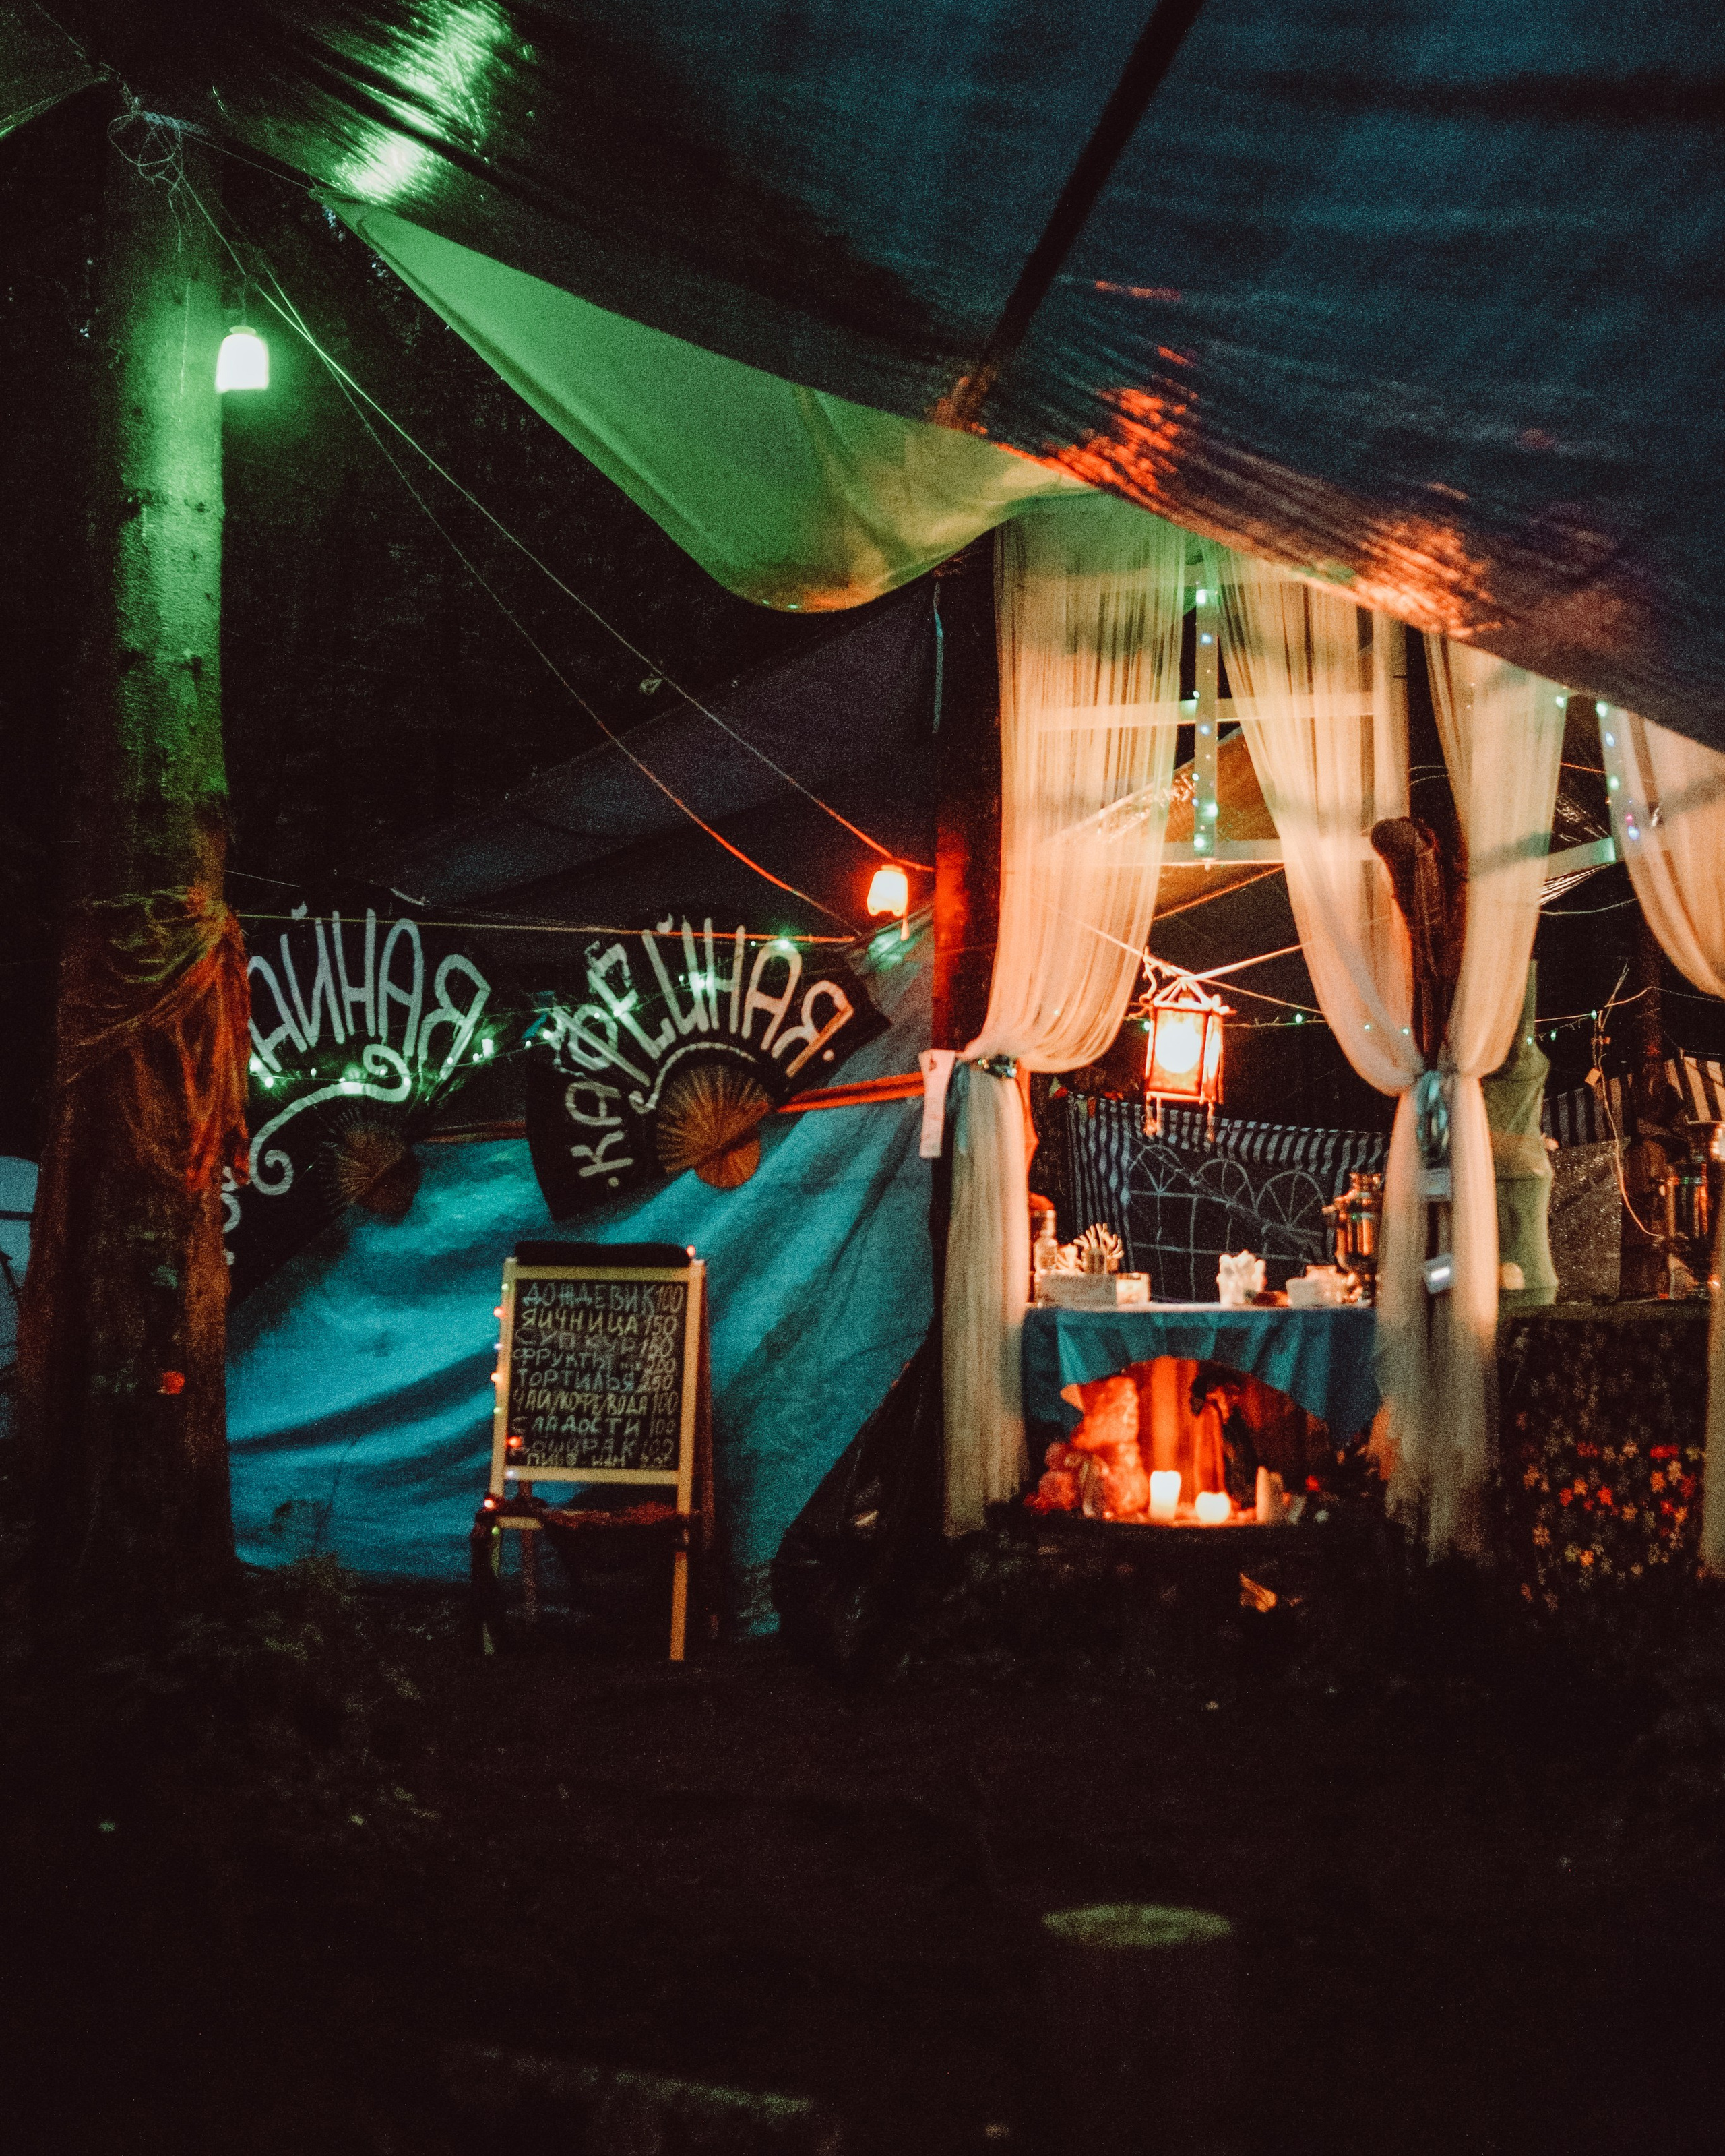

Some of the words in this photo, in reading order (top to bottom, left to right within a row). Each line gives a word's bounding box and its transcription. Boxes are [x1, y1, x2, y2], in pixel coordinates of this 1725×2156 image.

[522, 1283, 654, 1314] ДОЖДЕВИК
[656, 1285, 683, 1313] 100
[522, 1307, 638, 1336] ЯИЧНИЦА
[643, 1315, 677, 1336] 150
[515, 1328, 575, 1349] СУП
[640, 1334, 675, 1357] 150
[513, 1347, 614, 1372] ФРУКТЫ
[518, 1368, 635, 1392] ТОРТИЛЬЯ
[651, 1391, 679, 1417] 100
[512, 1415, 641, 1437] СЛАДОСТИ
[649, 1419, 675, 1438] 100
